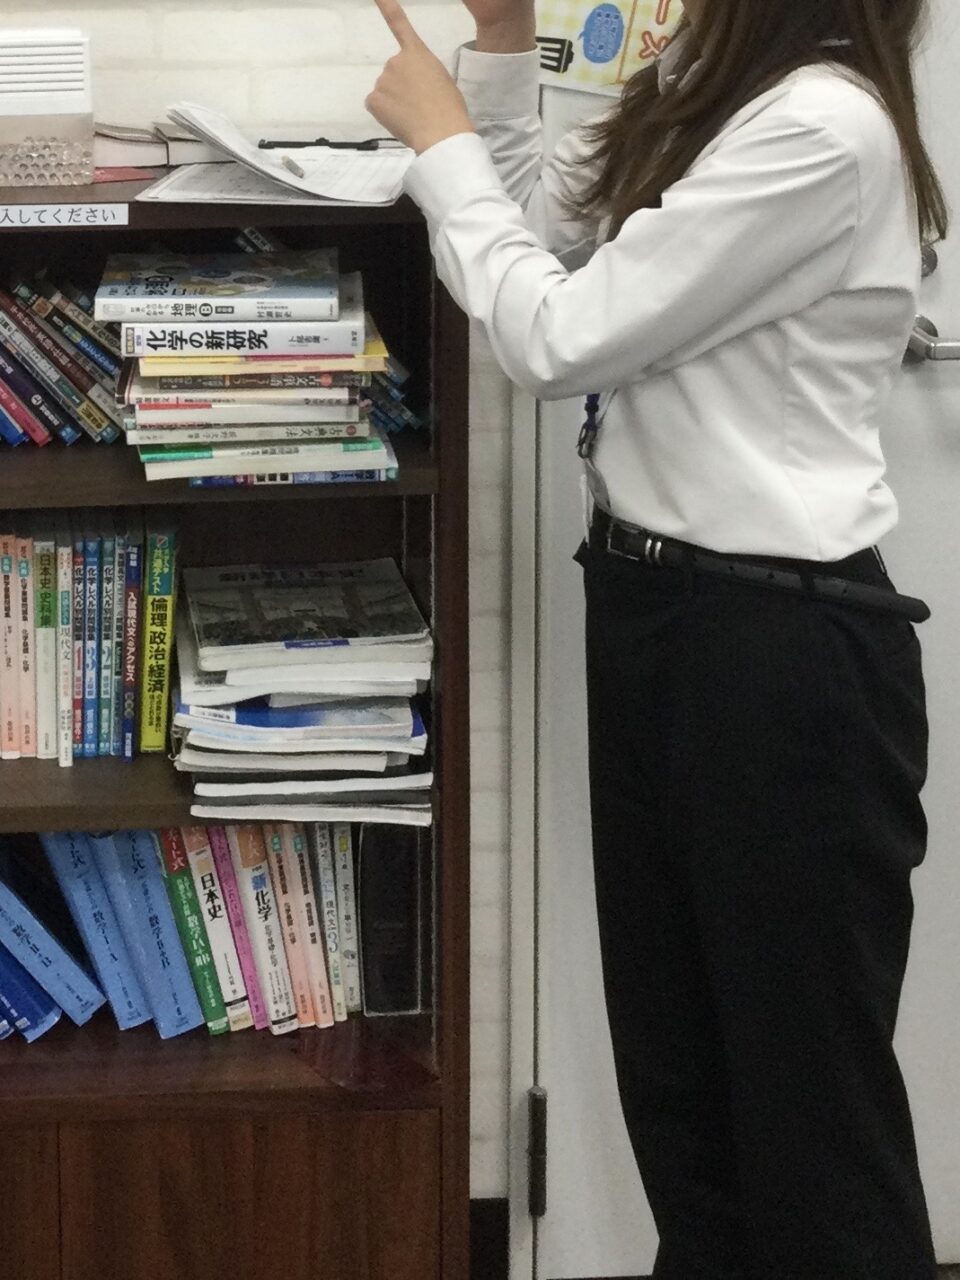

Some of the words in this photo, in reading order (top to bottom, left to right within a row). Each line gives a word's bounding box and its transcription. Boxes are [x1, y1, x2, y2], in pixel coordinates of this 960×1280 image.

[146, 329, 268, 351] 化学の新研究
[200, 872, 224, 922] 日本史
